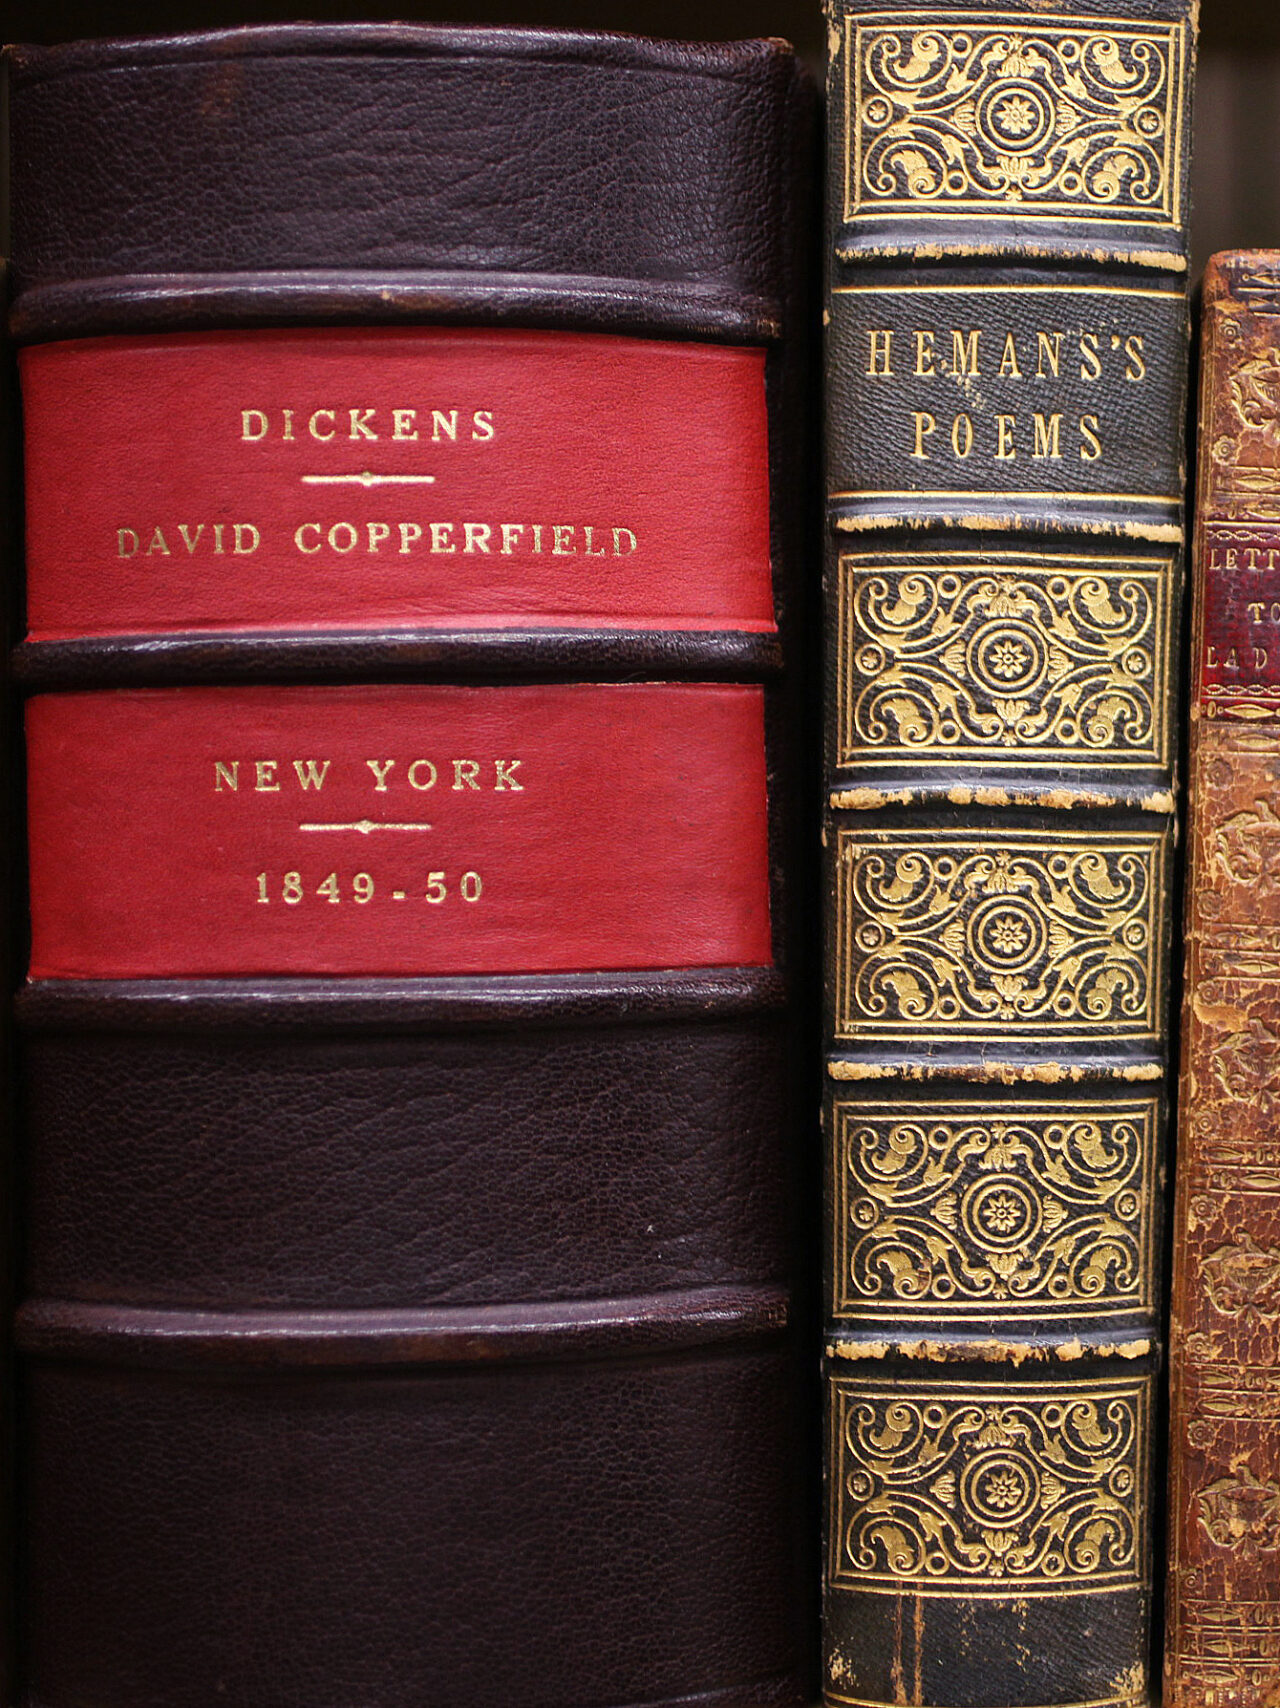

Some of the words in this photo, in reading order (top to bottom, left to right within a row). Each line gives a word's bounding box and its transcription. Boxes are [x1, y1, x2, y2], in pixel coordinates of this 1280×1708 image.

[866, 329, 1146, 382] HEMANS'S
[240, 409, 497, 442] DICKENS
[909, 411, 1103, 461] POEMS
[116, 522, 262, 558] DAVID
[294, 522, 639, 556] COPPERFIELD
[213, 760, 331, 791] NEW
[366, 760, 524, 792] YORK
